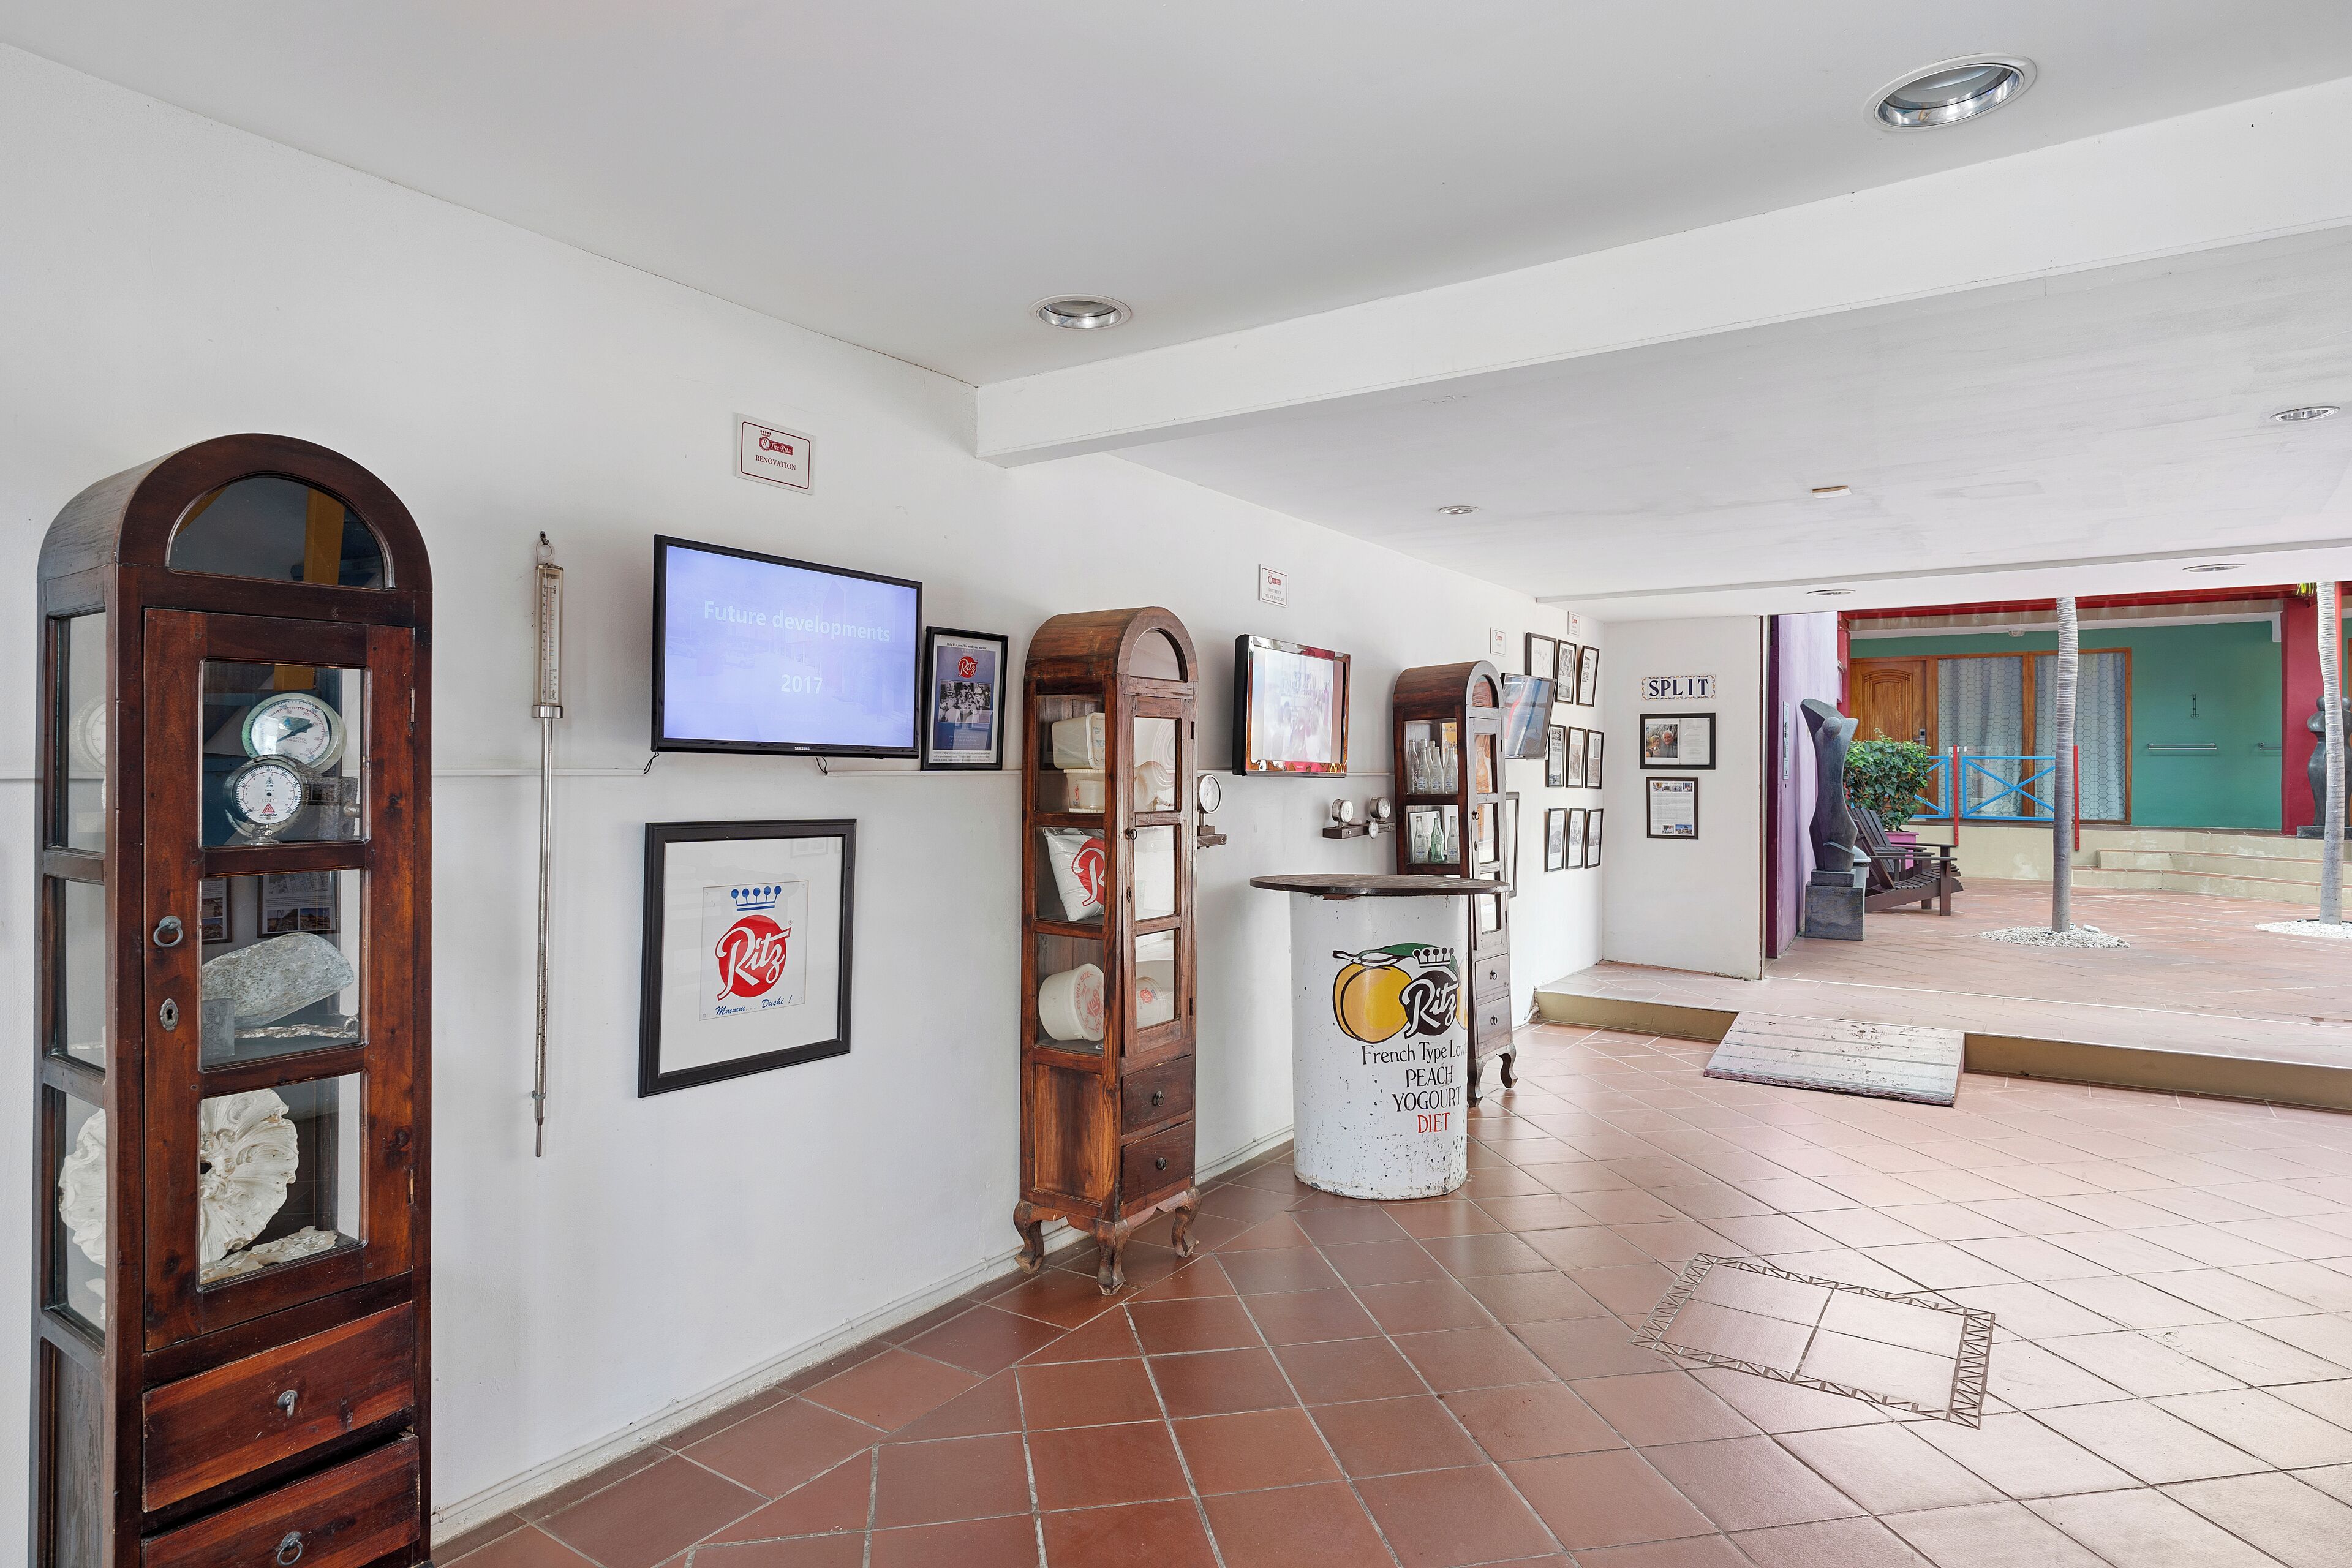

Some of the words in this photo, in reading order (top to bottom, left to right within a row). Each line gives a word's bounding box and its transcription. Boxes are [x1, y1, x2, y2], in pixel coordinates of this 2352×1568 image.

[780, 445, 792, 454] Ritz
[755, 455, 796, 470] RENOVATION
[704, 600, 766, 626] Future
[772, 610, 891, 643] developments
[958, 658, 978, 677] Ritz
[781, 674, 823, 694] 2017
[1649, 679, 1708, 696] SPLIT
[715, 927, 791, 1001] Ritz
[1080, 971, 1091, 982] SIZE
[762, 996, 784, 1008] Dushi
[1400, 979, 1459, 1038] Ritz
[1362, 1044, 1416, 1065] French
[1418, 1041, 1447, 1064] Type
[1405, 1065, 1453, 1088] PEACH
[1392, 1085, 1462, 1112] YOGOURT
[1417, 1112, 1451, 1133] DIET
